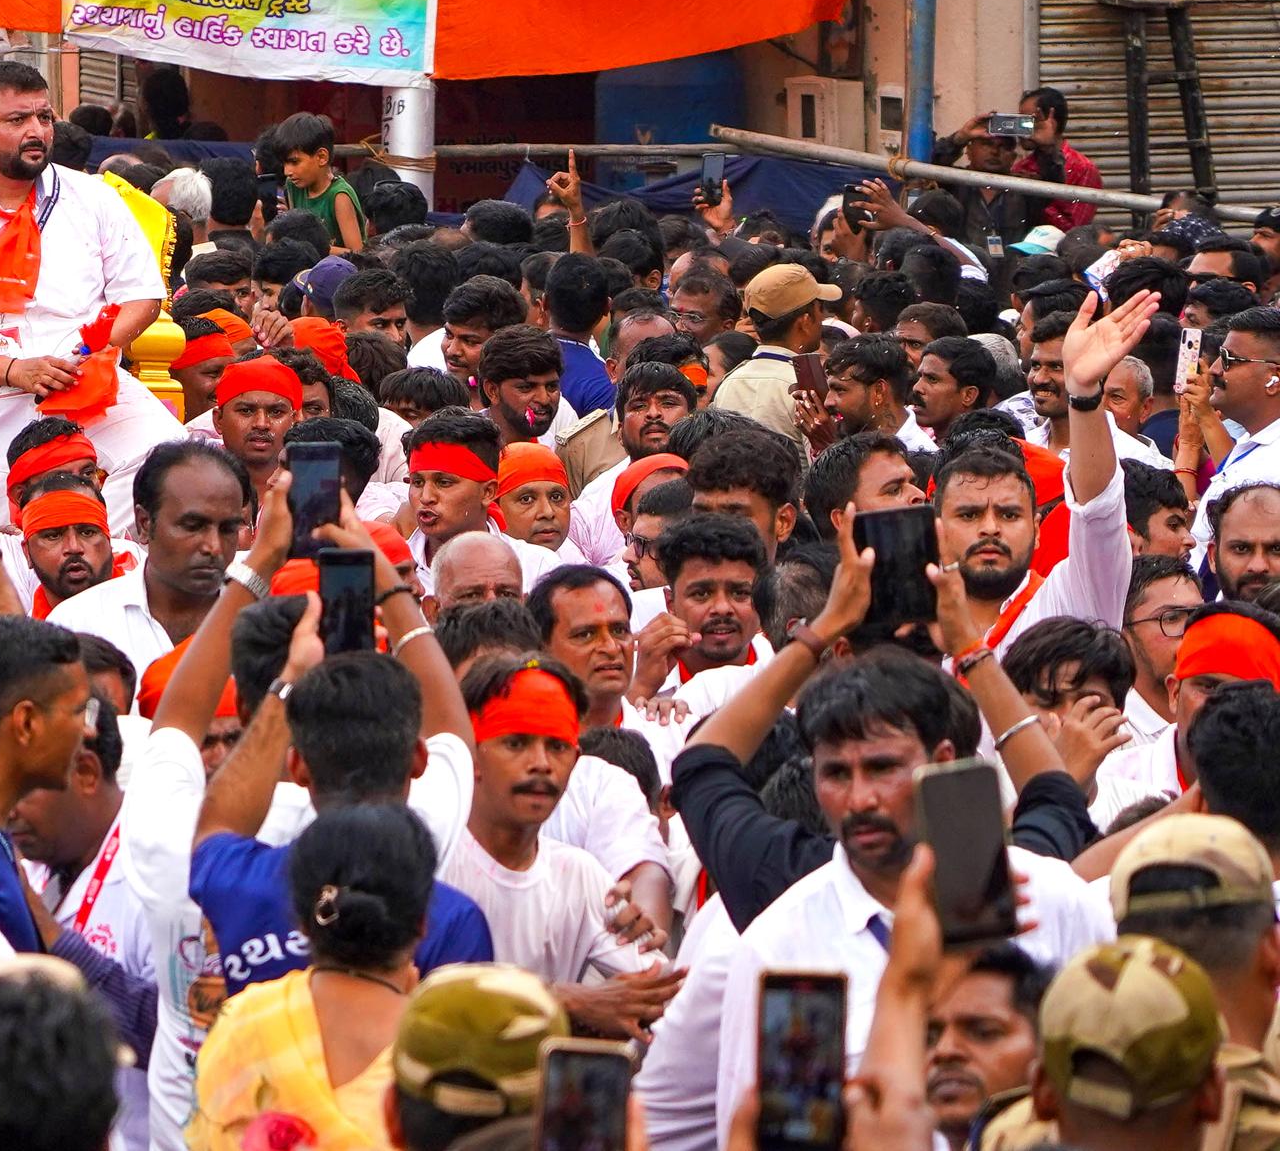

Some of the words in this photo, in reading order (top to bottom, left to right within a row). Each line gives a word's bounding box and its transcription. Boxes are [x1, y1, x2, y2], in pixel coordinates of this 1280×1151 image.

[71, 4, 167, 40] રથયાત્રાનું
[173, 14, 242, 46] હાર્દિક
[251, 27, 326, 53] સ્વાગત
[334, 25, 370, 55] કરે
[380, 27, 411, 58] છે.
